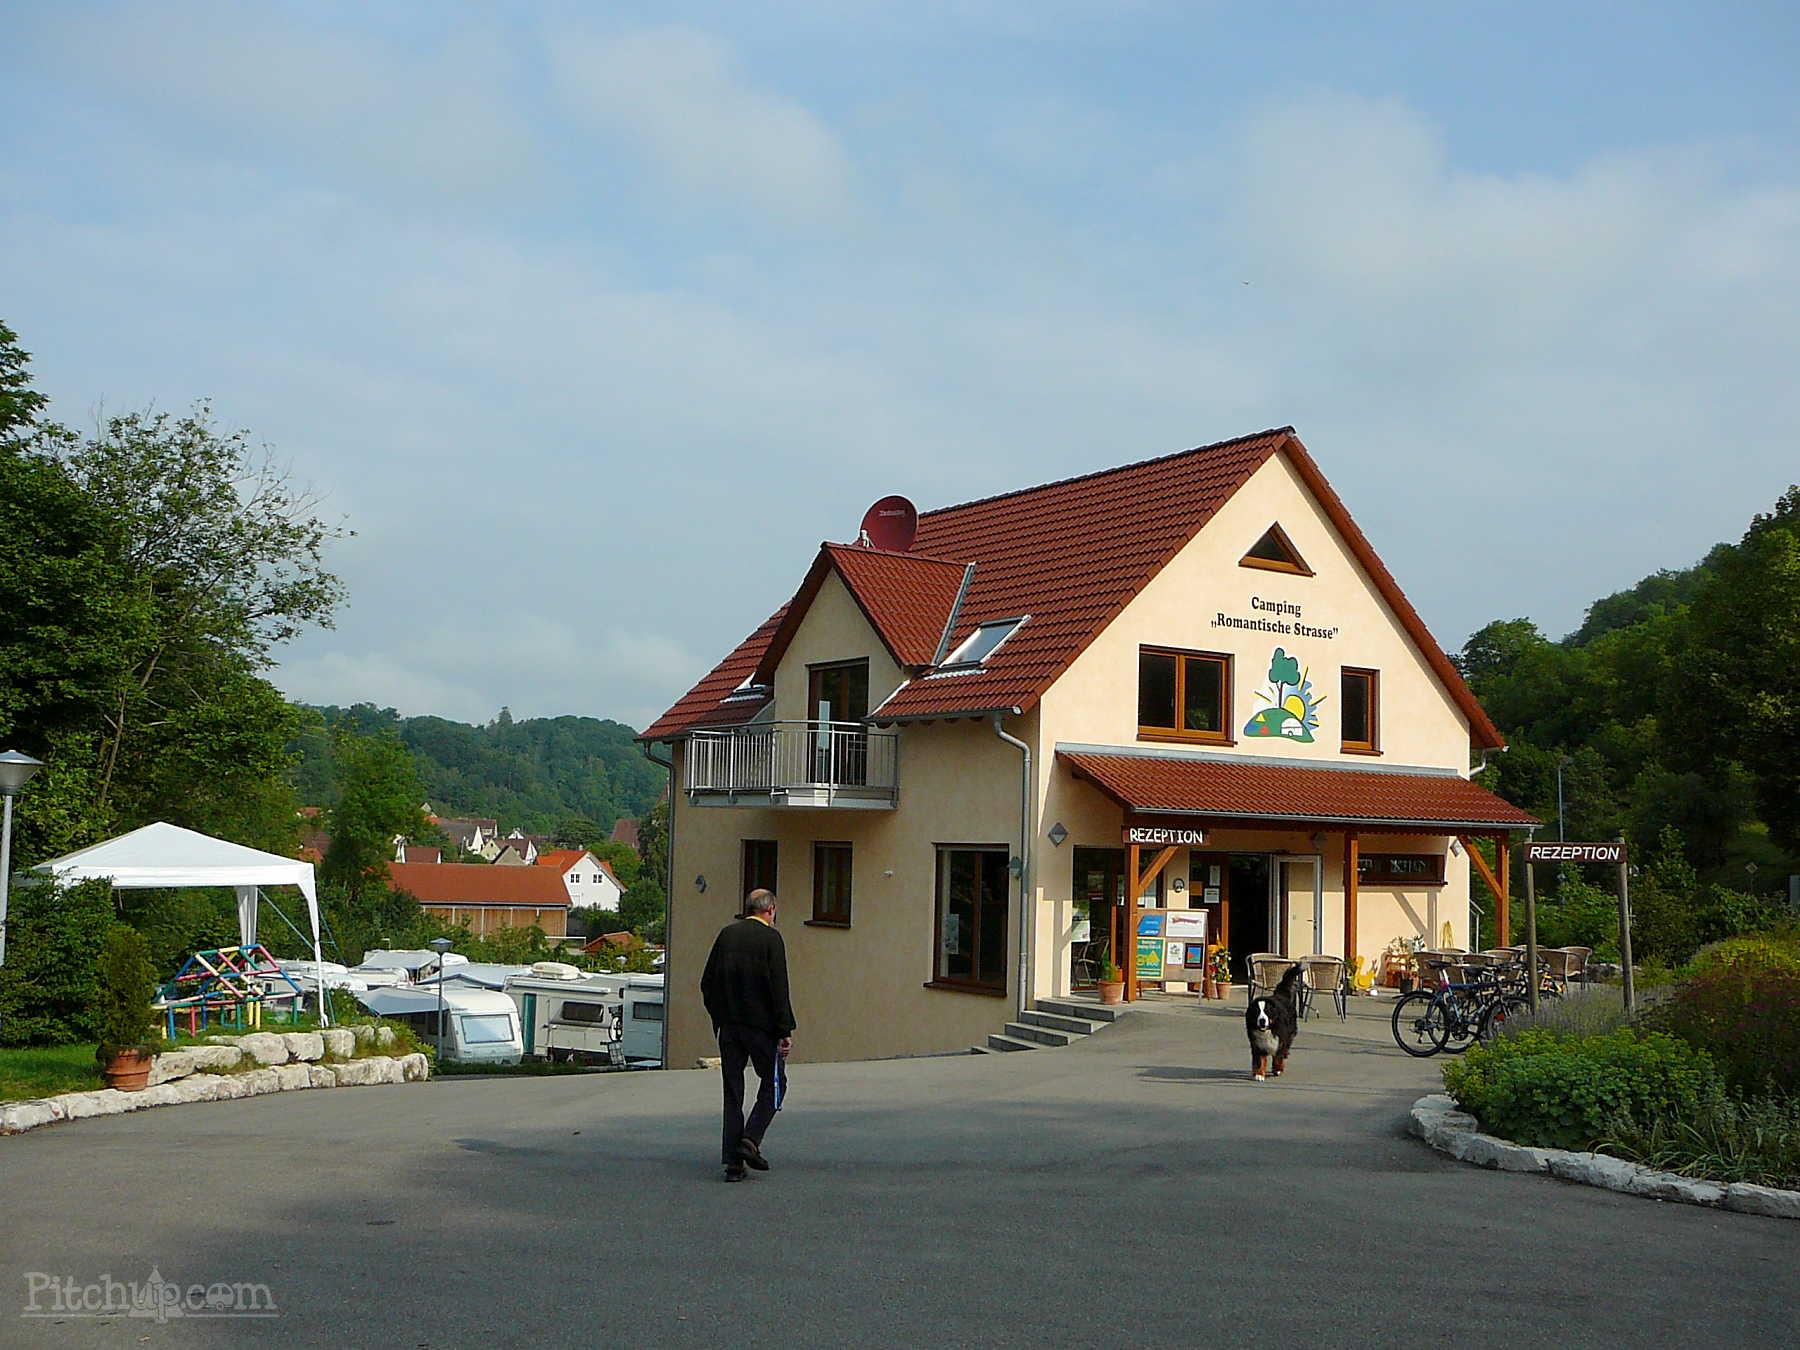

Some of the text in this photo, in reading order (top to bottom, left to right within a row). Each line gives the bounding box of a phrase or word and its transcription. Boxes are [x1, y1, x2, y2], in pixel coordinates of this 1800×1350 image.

[1251, 597, 1302, 617] Camping
[1129, 828, 1203, 844] REZEPTION
[1529, 846, 1620, 861] REZEPTION
